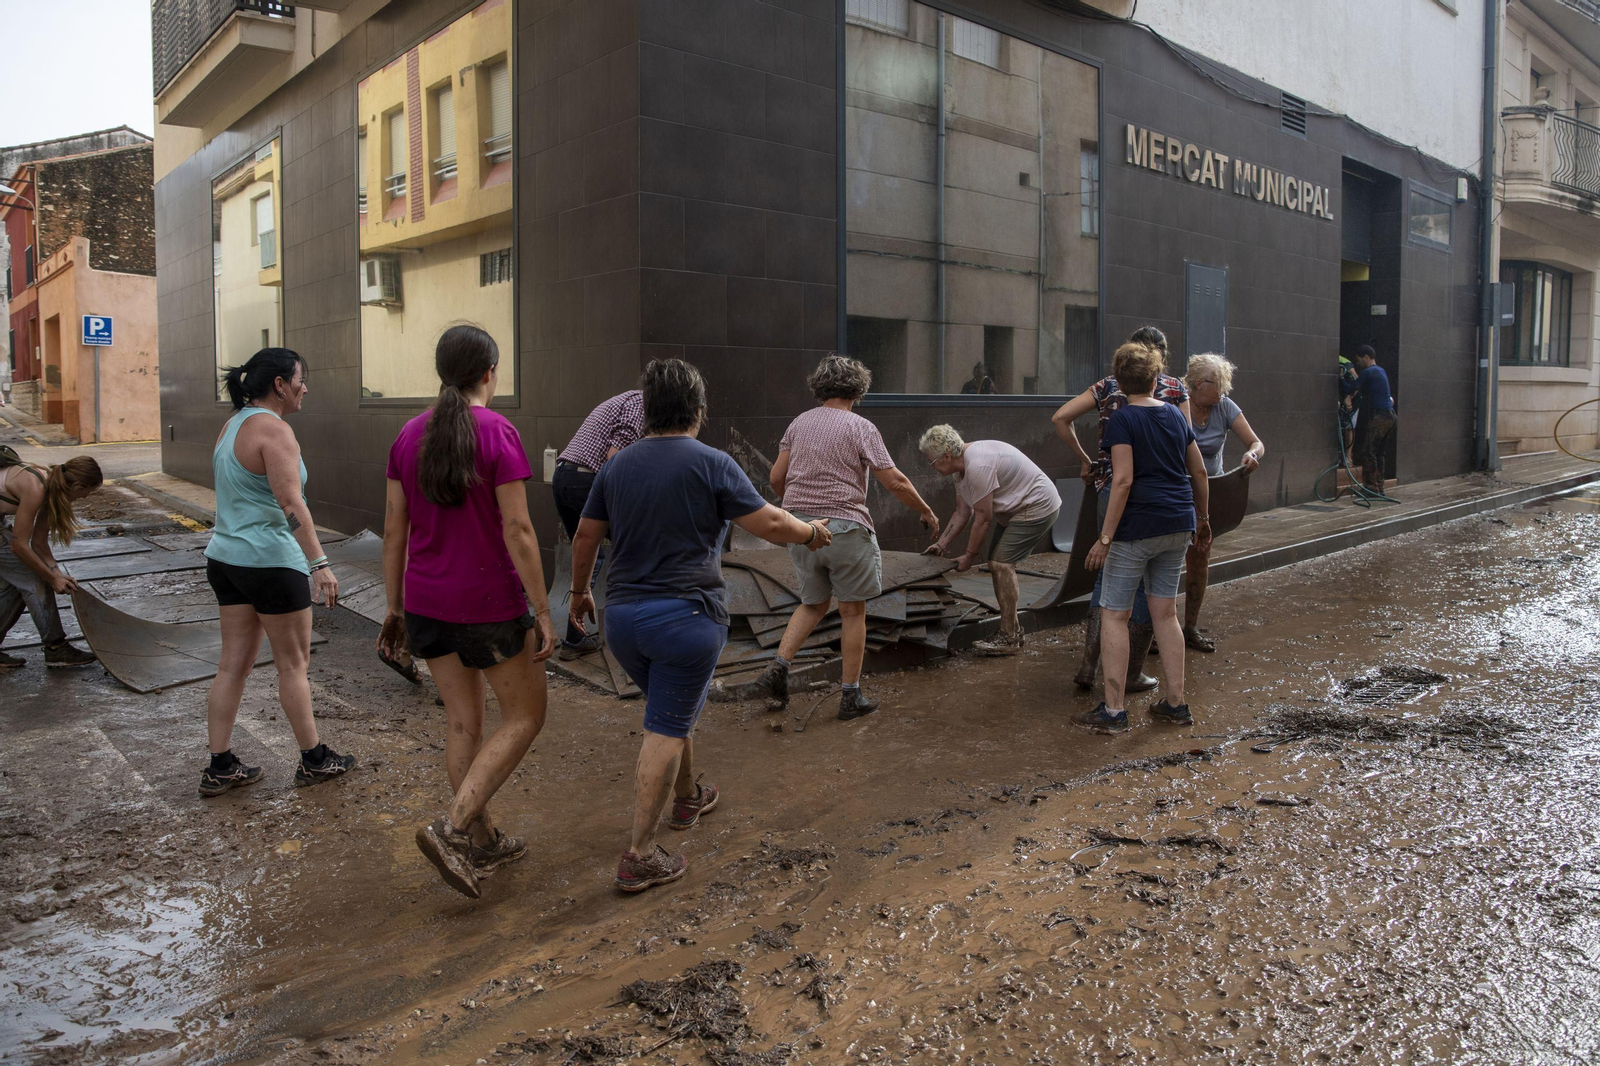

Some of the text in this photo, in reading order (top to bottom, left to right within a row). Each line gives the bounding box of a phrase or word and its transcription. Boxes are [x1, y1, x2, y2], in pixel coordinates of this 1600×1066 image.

[1125, 124, 1334, 220] MERCAT MUNICIPAL
[90, 318, 105, 335] P
